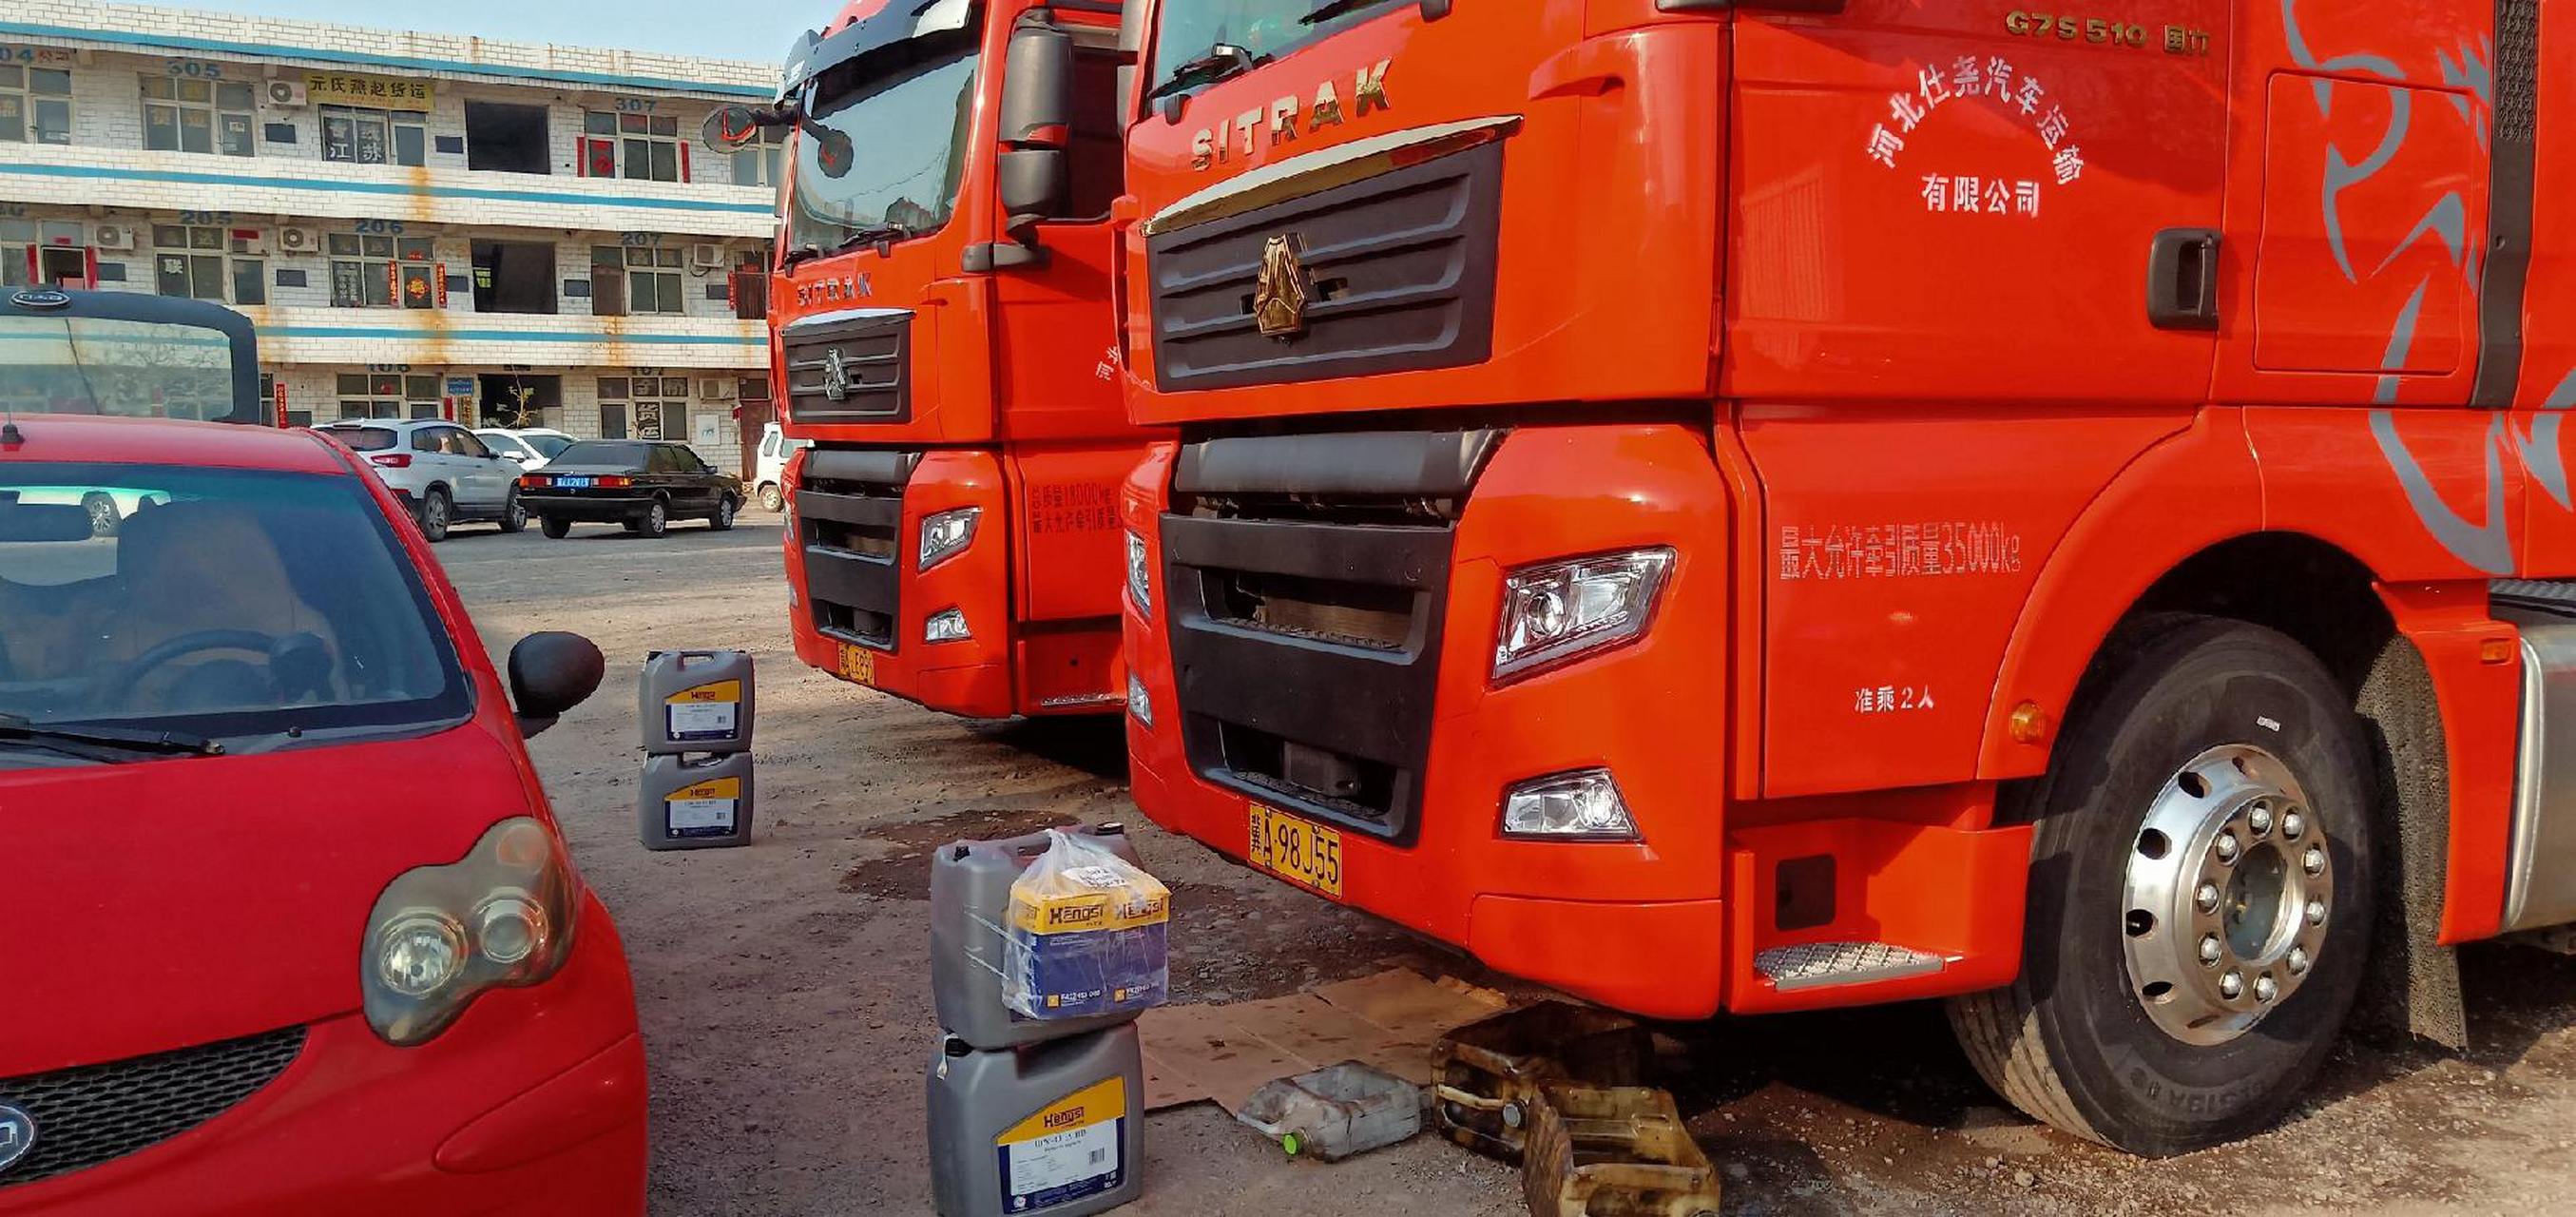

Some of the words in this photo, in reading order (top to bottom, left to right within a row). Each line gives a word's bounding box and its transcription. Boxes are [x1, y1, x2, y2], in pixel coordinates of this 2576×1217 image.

[2006, 10, 2078, 40] G7S
[2086, 17, 2147, 47] 510
[310, 76, 426, 98] 元氏燕赵货运
[615, 97, 657, 111] 307
[1190, 56, 1393, 172] SITRAK
[1921, 172, 2040, 218] 有限公司
[798, 272, 873, 307] SITRAK
[1779, 521, 2022, 580] 最大允许牵引质量35000kg
